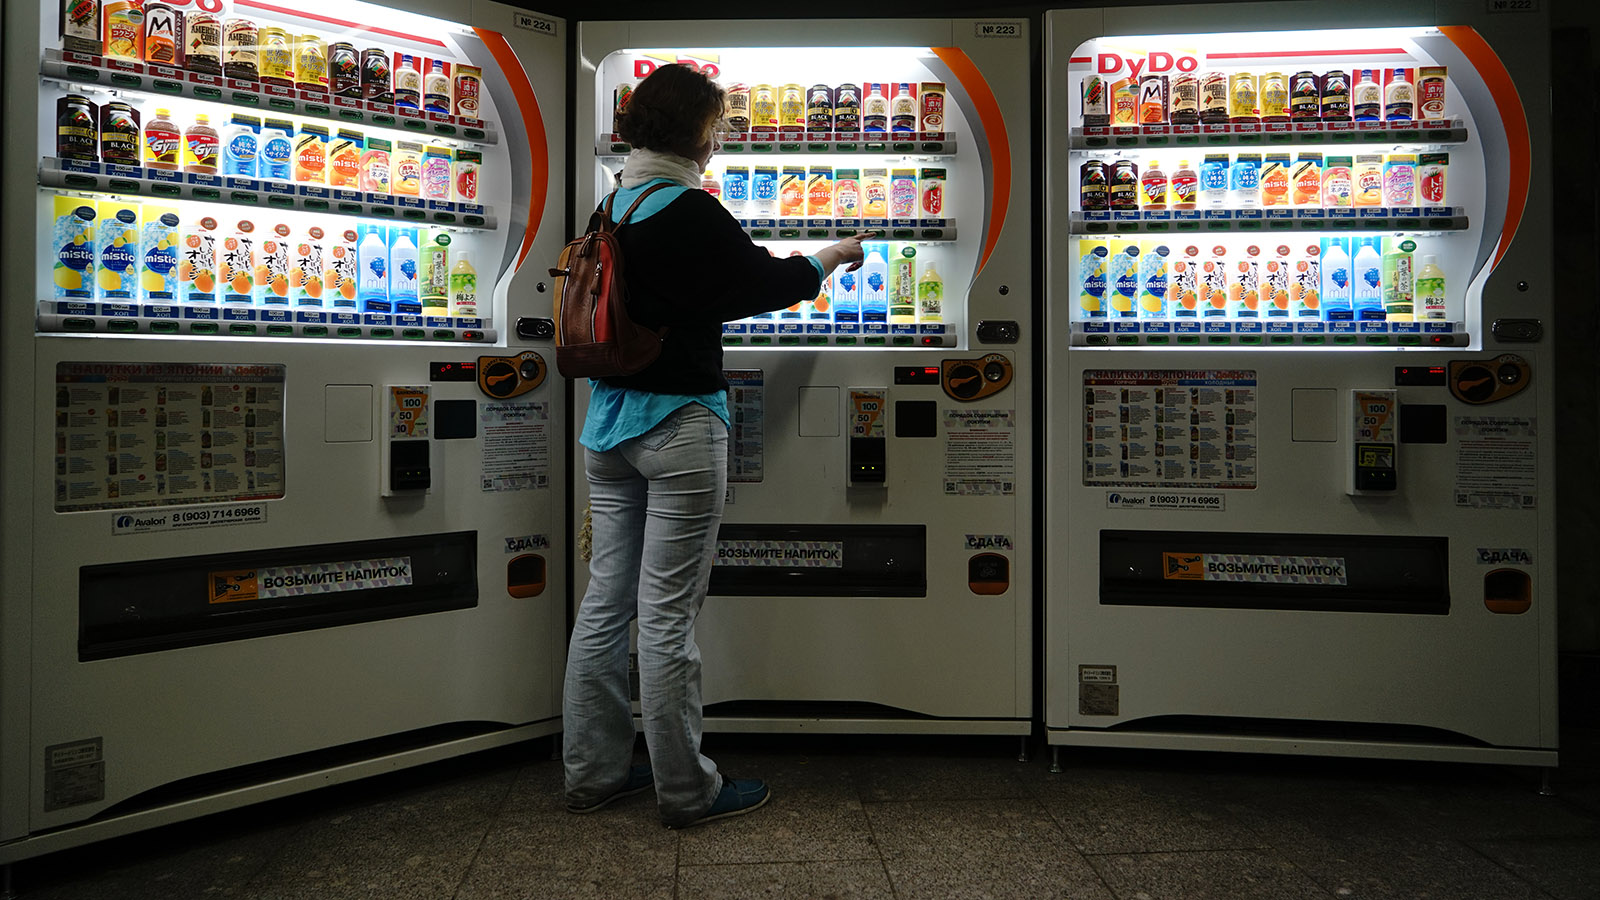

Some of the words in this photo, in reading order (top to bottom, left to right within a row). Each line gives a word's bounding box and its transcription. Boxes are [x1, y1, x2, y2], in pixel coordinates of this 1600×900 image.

[1510, 0, 1531, 9] 222
[521, 17, 532, 26] №
[534, 20, 551, 31] 224
[113, 30, 134, 39] コクとろ
[982, 26, 994, 34] №
[996, 26, 1015, 34] 223
[1098, 52, 1198, 79] DyDo
[59, 249, 94, 261] mistio
[101, 251, 136, 262] mistio
[144, 253, 177, 264] mistio
[72, 365, 141, 375] НАПИТКИ
[145, 366, 164, 375] ИЗ
[168, 366, 223, 374] ЯПОНИИ
[1096, 370, 1144, 379] НАПИТКИ
[1148, 371, 1160, 379] ИЗ
[1163, 371, 1206, 379] ЯПОНИИ
[399, 412, 412, 420] 50
[1157, 495, 1179, 503] (903)
[1181, 496, 1196, 504] 714
[135, 516, 166, 527] Avalon
[173, 514, 179, 522] 8
[182, 510, 210, 522] (903)
[213, 509, 232, 518] 714
[234, 507, 260, 516] 6966
[508, 537, 548, 551] СДАЧА
[969, 538, 1010, 548] СДАЧА
[718, 549, 782, 558] ВОЗЬМИТЕ
[784, 550, 838, 559] НАПИТОК
[1481, 552, 1528, 563] СДАЧА
[1208, 563, 1279, 574] ВОЗЬМИТЕ
[1281, 565, 1341, 576] НАПИТОК
[264, 572, 343, 589] ВОЗЬМИТЕ
[346, 567, 408, 581] НАПИТОК
